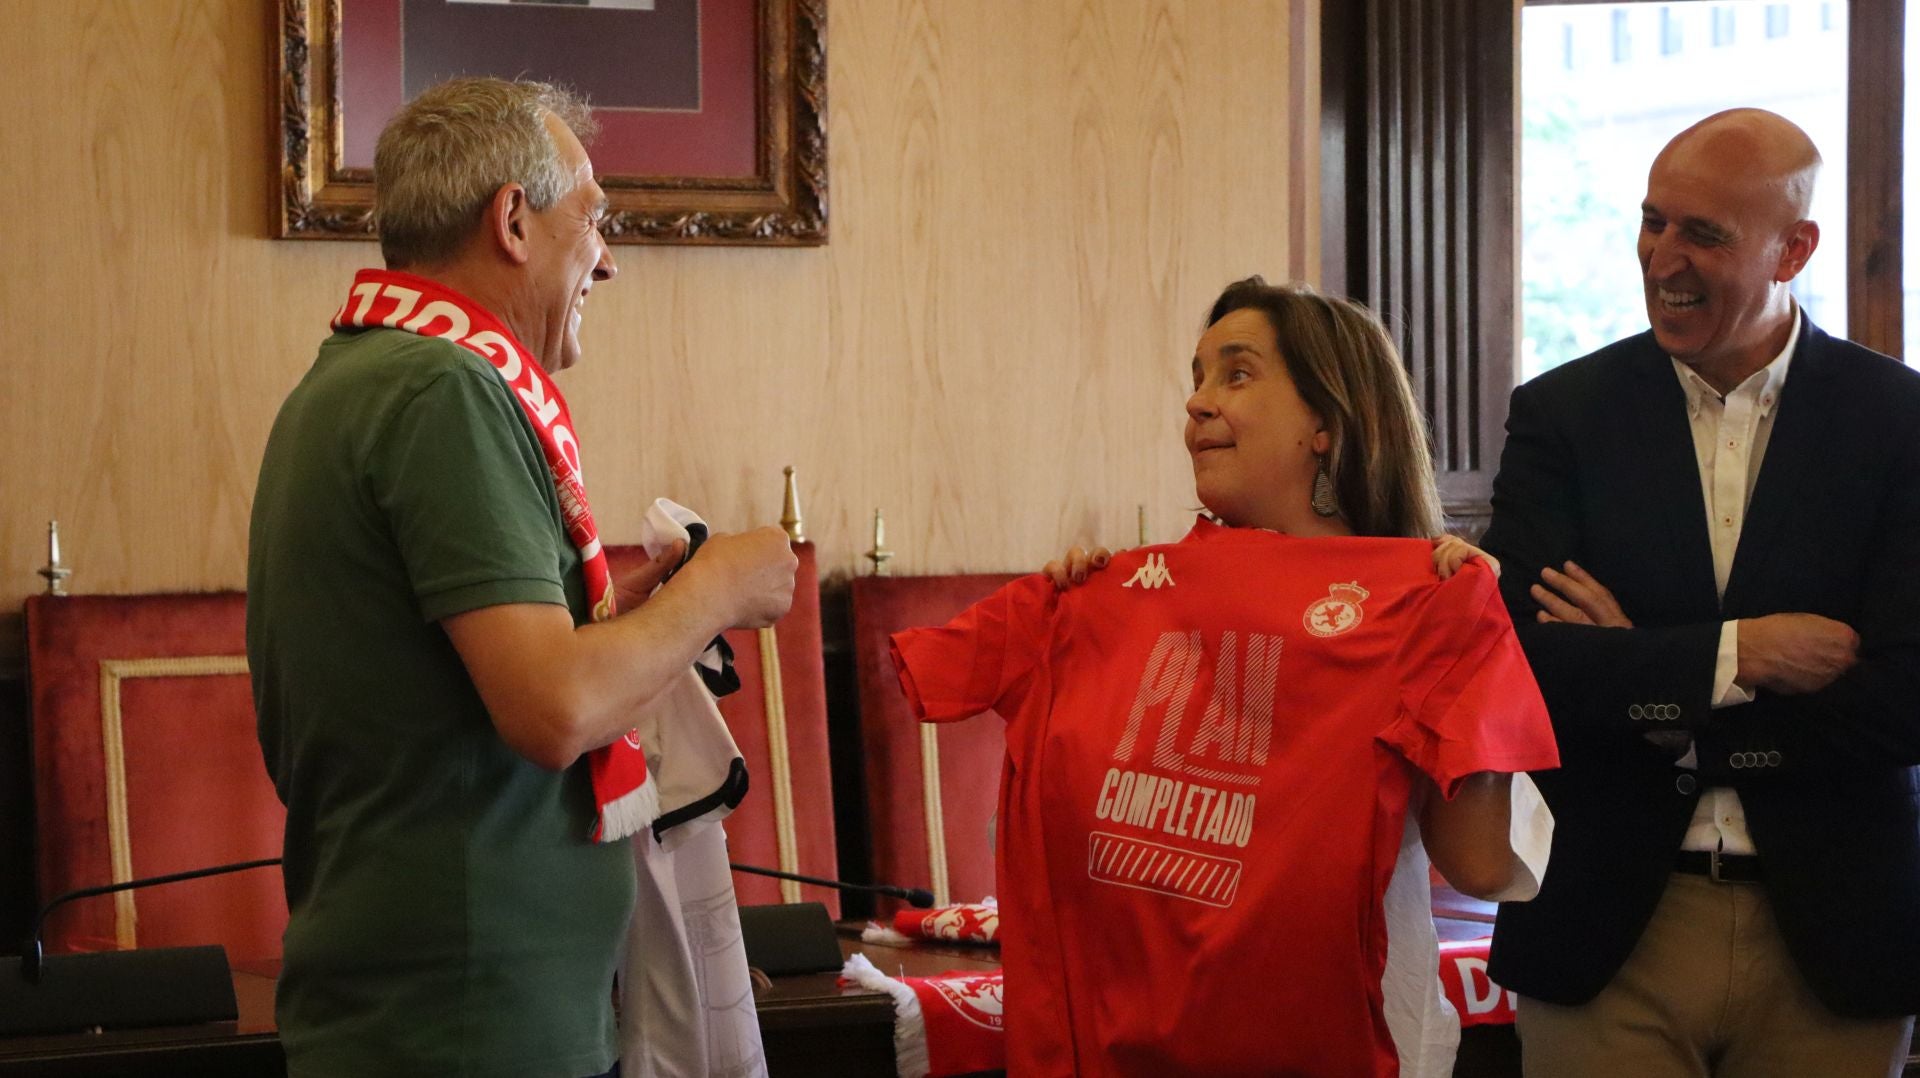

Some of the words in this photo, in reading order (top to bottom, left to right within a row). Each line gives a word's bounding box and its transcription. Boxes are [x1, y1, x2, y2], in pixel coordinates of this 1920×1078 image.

[334, 282, 583, 486] ORGULL
[1112, 630, 1283, 780] PLAN
[1096, 767, 1255, 847] COMPLETADO
